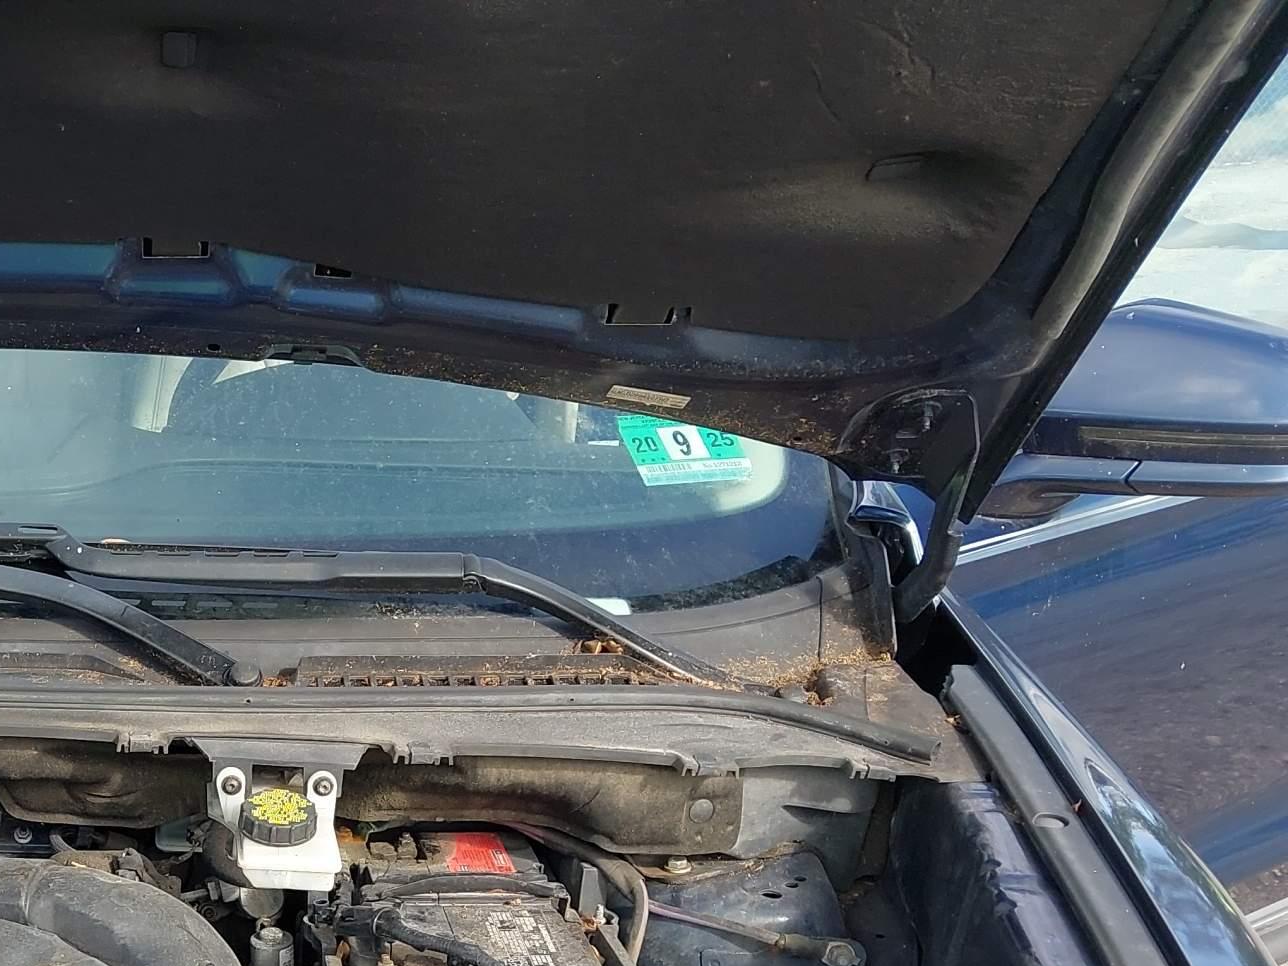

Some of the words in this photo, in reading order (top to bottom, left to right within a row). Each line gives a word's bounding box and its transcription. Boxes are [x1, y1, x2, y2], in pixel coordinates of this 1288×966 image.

[631, 436, 659, 454] 20
[672, 430, 692, 456] 9
[707, 432, 735, 448] 25
